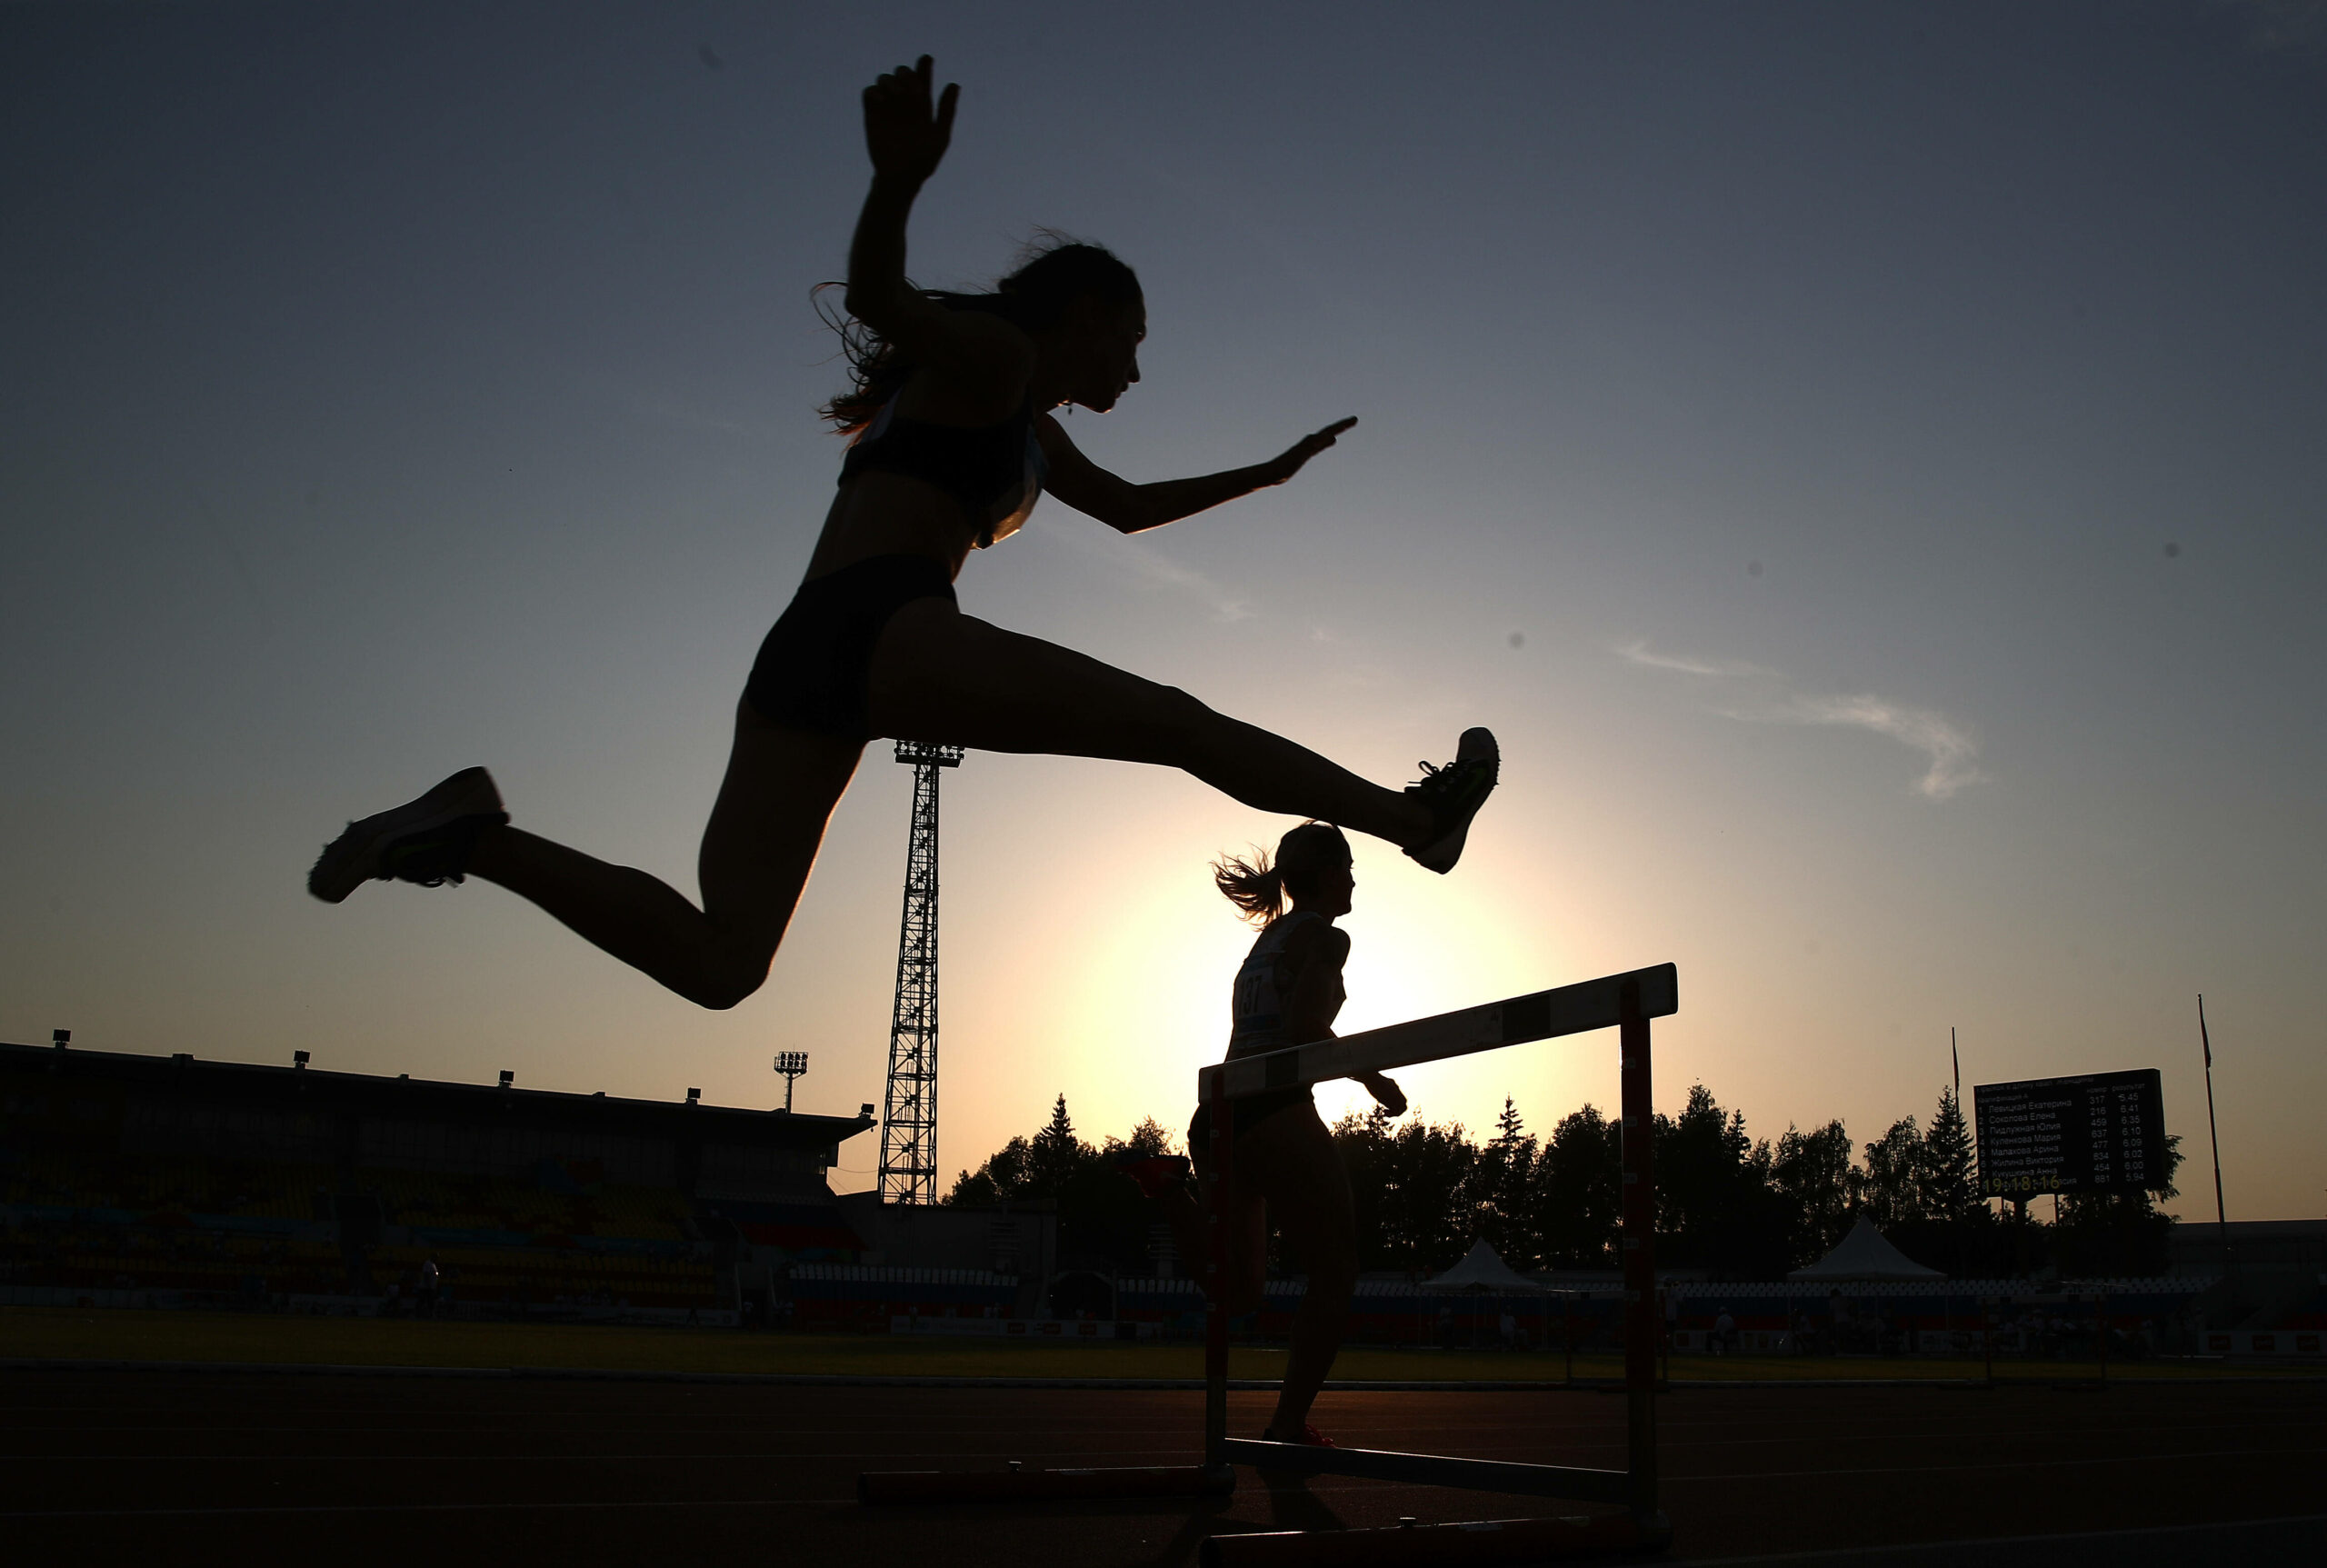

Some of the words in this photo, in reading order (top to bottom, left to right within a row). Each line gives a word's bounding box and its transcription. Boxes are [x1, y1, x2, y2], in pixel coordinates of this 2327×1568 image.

[1238, 974, 1263, 1015] 137
[2089, 1095, 2105, 1104] 317
[2030, 1112, 2056, 1121] Елена
[2090, 1106, 2106, 1116] 216
[2037, 1123, 2061, 1131] Юлия
[2091, 1118, 2108, 1127] 459
[2034, 1134, 2062, 1143] Мария
[2092, 1140, 2109, 1149] 477
[2025, 1156, 2064, 1165] Виктория
[2037, 1167, 2058, 1175] Анна
[1984, 1174, 2062, 1193] 19:18:16
